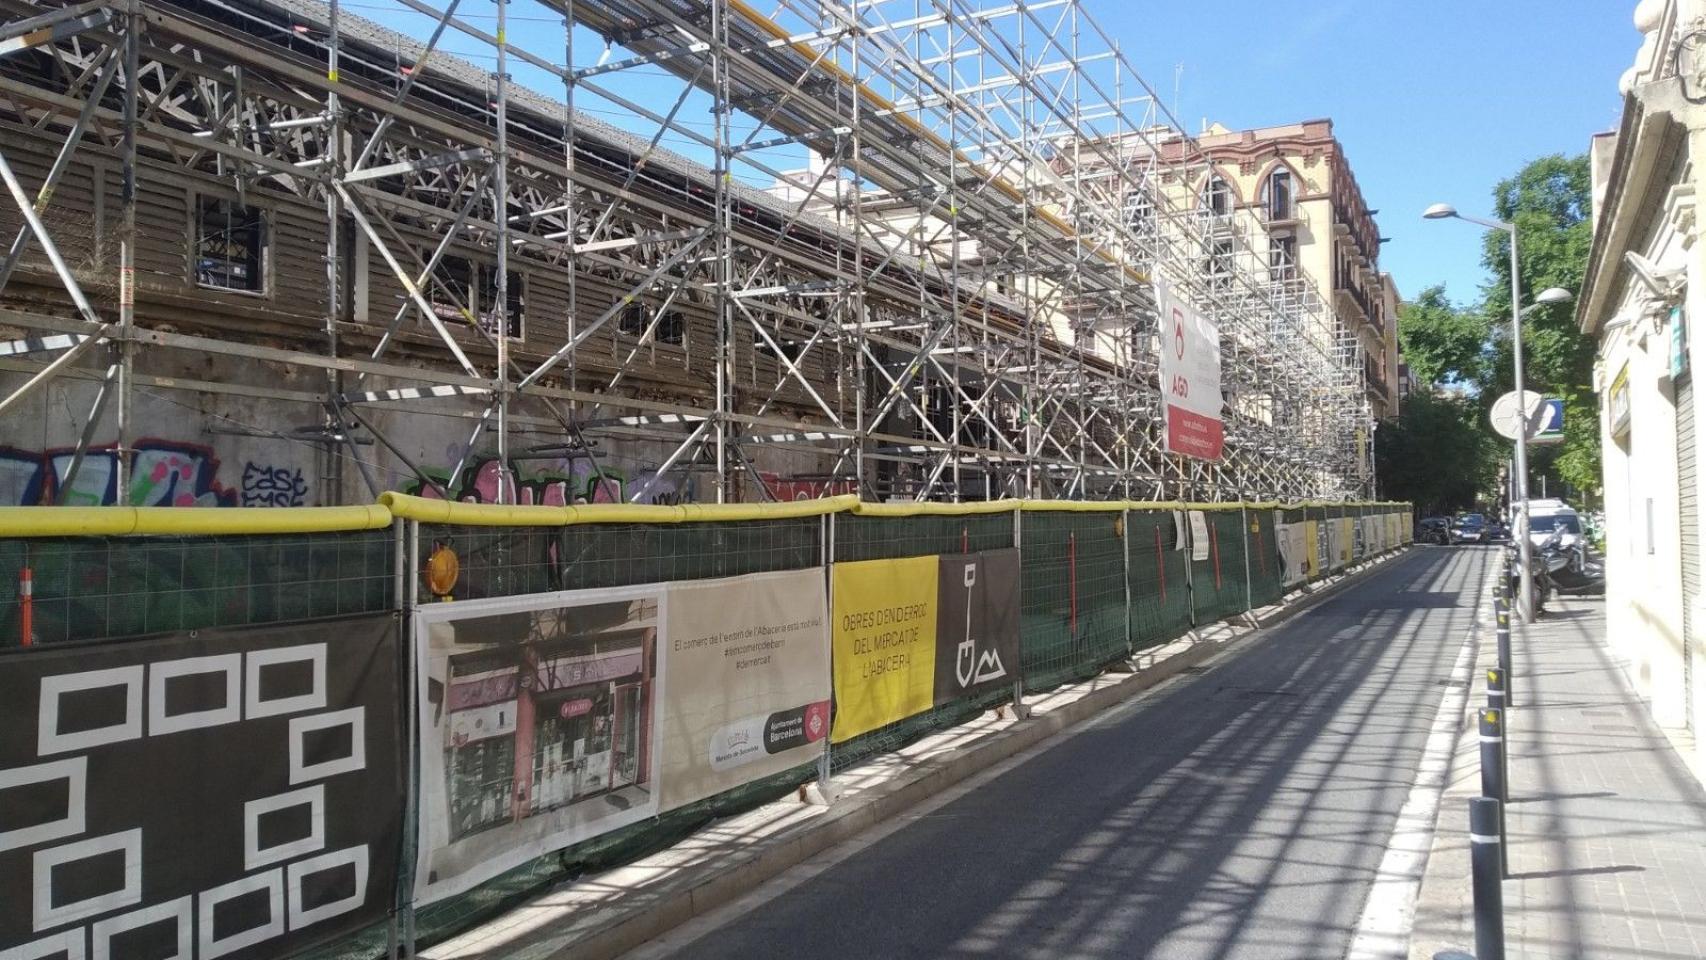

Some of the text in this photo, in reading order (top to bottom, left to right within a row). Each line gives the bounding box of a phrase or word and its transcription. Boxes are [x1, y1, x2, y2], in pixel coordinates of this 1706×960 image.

[843, 611, 874, 632] OBRES
[674, 640, 682, 652] El
[854, 637, 872, 656] DEL
[770, 727, 803, 743] Barcelona
